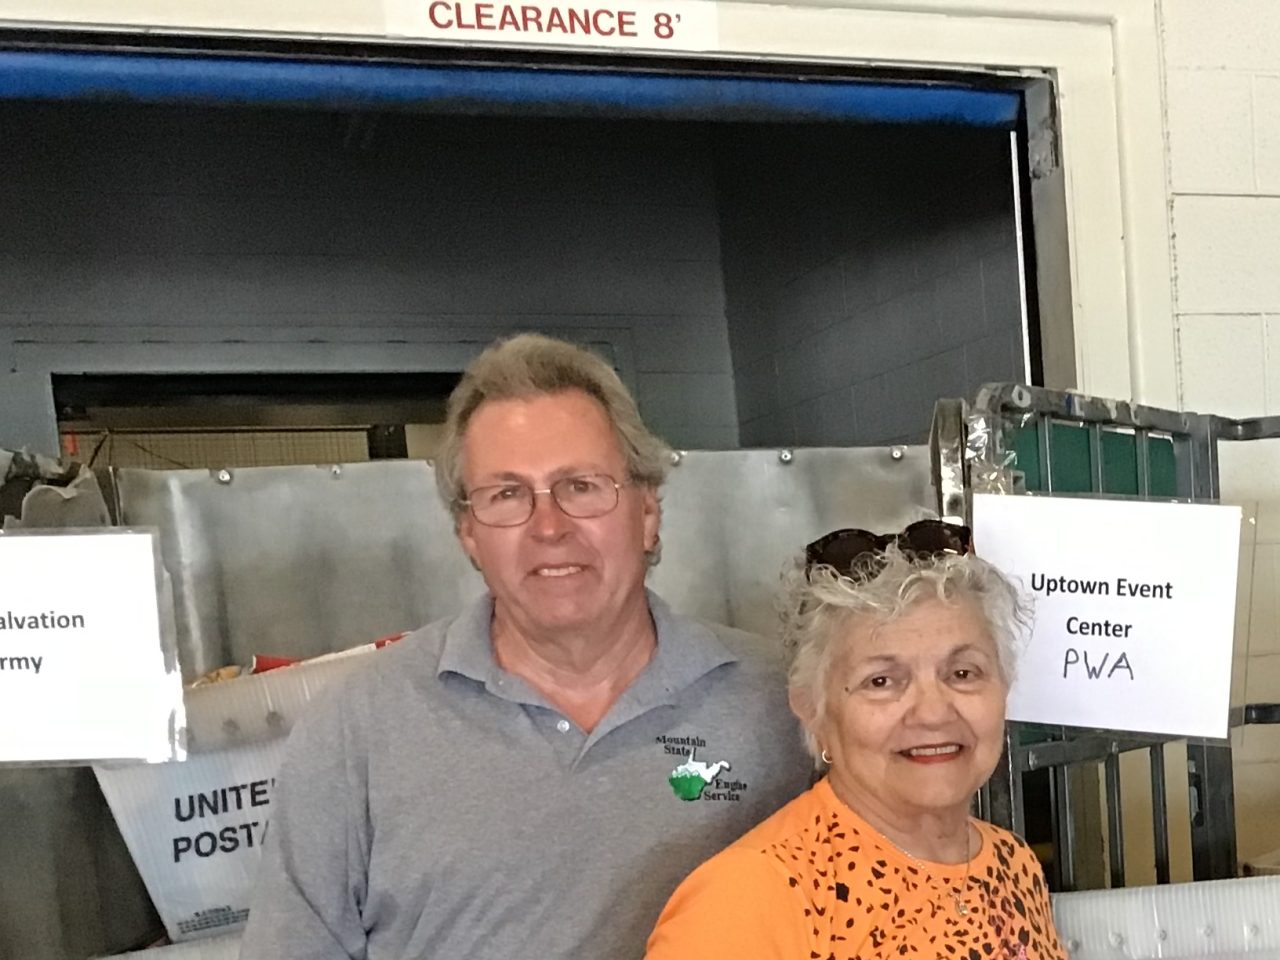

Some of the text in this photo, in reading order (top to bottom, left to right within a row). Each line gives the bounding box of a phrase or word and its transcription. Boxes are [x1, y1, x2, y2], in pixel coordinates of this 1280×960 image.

[428, 1, 682, 39] CLEARANCE 8'
[1031, 573, 1173, 599] Uptown Event
[0, 610, 85, 629] alvation
[1066, 616, 1133, 638] Center
[0, 656, 43, 674] rmy
[1063, 648, 1134, 680] PWA
[656, 735, 706, 747] Mountain
[664, 745, 691, 756] State
[174, 777, 276, 822] UNITE
[704, 791, 741, 801] Service
[173, 820, 270, 863] POST
